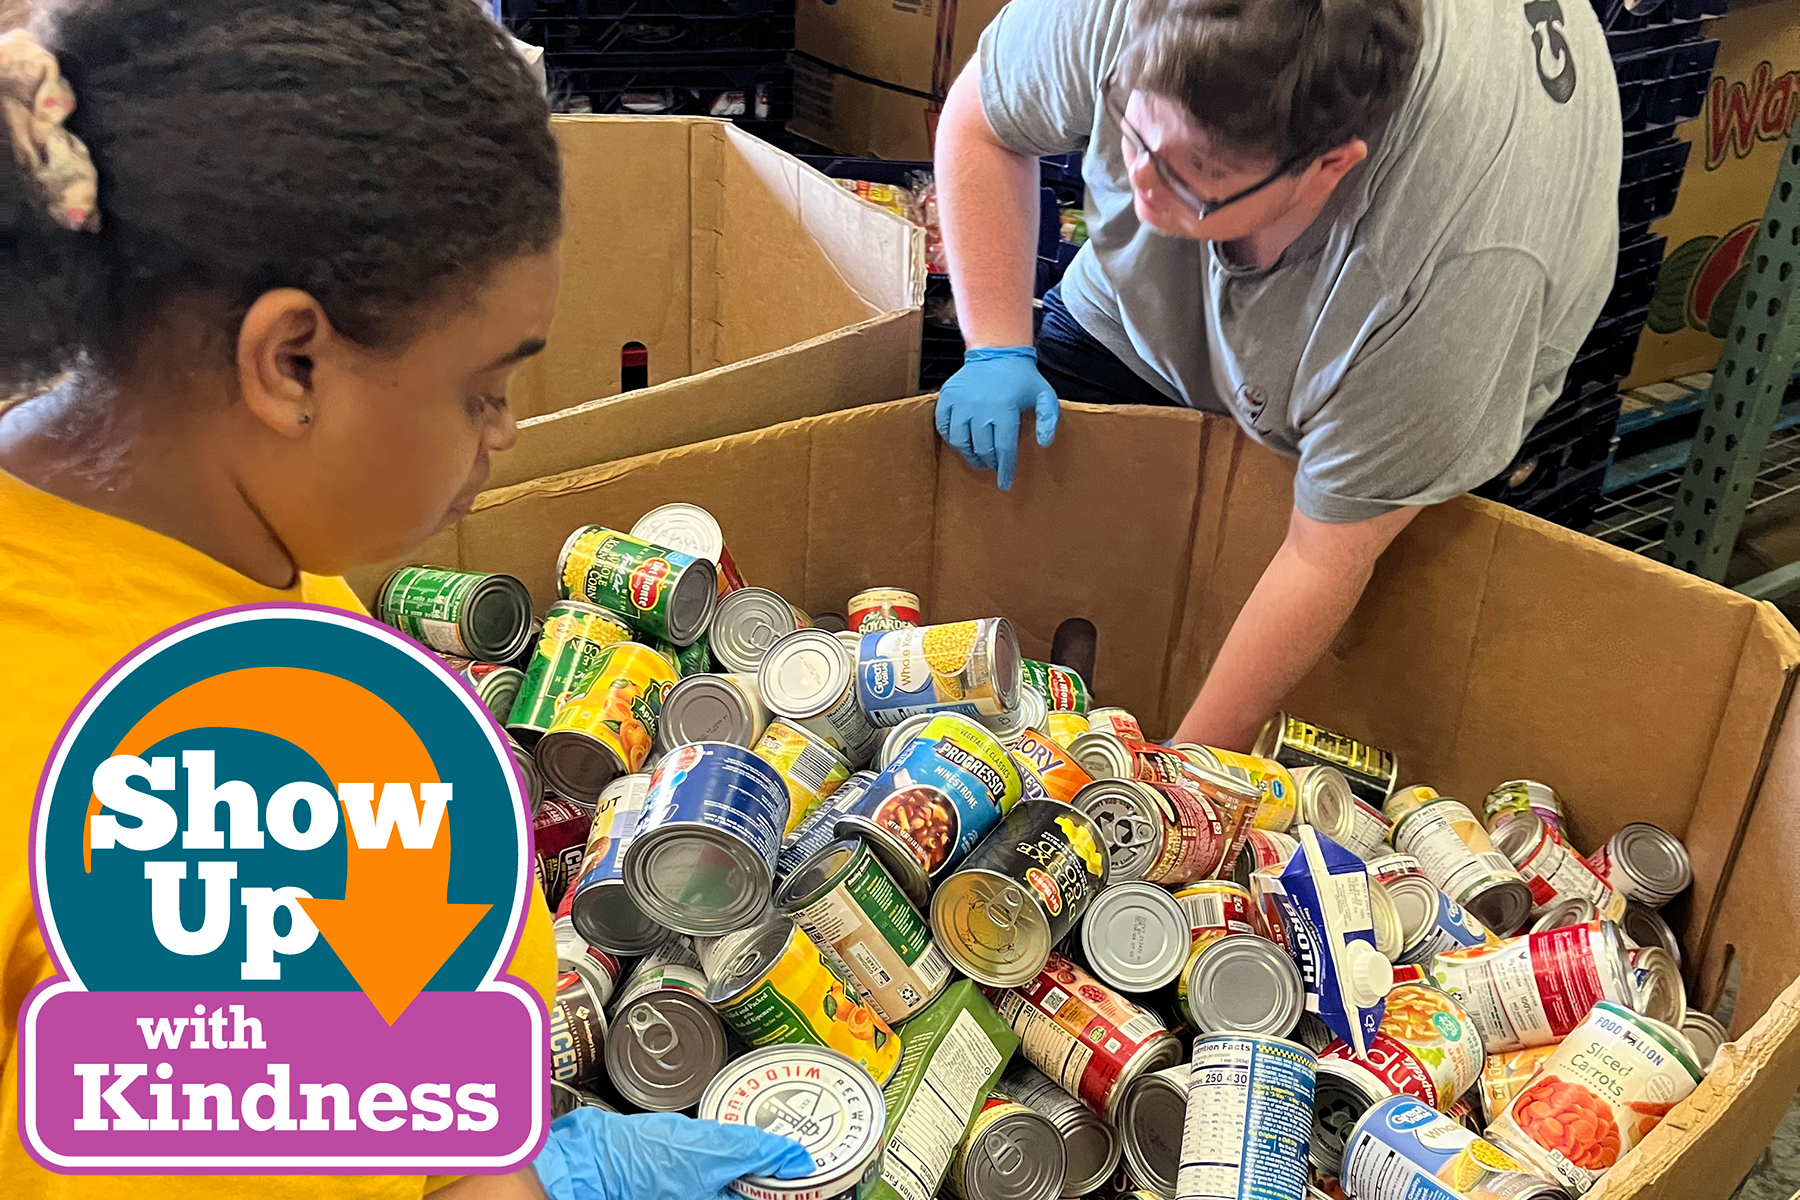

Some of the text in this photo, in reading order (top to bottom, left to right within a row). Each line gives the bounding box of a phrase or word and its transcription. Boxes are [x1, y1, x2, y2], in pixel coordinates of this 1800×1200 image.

[583, 569, 602, 599] CORN
[616, 587, 630, 611] WITH
[638, 561, 665, 607] Del Monte
[874, 658, 885, 694] Great
[881, 660, 889, 690] Value
[902, 653, 911, 686] Whoe
[939, 742, 1003, 796] PROGRESSO
[959, 729, 1010, 779] VEGETABLE CLASSICS
[1014, 733, 1065, 776] LORY
[934, 765, 978, 810] MINESTRONE
[1416, 806, 1436, 818] Facts
[1436, 819, 1447, 828] 20
[1016, 842, 1078, 921] DELUXE
[1038, 839, 1085, 899] GOLD
[1029, 868, 1061, 911] Del Monte
[1282, 902, 1315, 983] BROTH
[738, 1005, 750, 1016] and
[746, 991, 769, 1009] Packed
[749, 1003, 776, 1024] Ripeness
[998, 990, 1015, 1011] Facts
[1022, 1004, 1034, 1017] 30
[1519, 995, 1532, 1014] 100%
[551, 1005, 577, 1080] DICED
[562, 1001, 577, 1034] NATURALLY
[574, 1036, 582, 1057] STEAM
[1594, 1016, 1665, 1067] FOOD LION
[1222, 1043, 1250, 1052] Facts
[1586, 1042, 1634, 1077] Sliced
[1205, 1073, 1223, 1083] 250
[1227, 1074, 1247, 1084] 430
[1401, 1054, 1434, 1108] ampbell's
[1570, 1053, 1624, 1097] Carrots
[724, 1066, 821, 1122] WILD CAUG
[838, 1110, 864, 1149] WELL
[1391, 1105, 1426, 1125] Great
[1424, 1123, 1460, 1139] Whol
[816, 1152, 838, 1167] FO
[889, 1139, 903, 1152] 10
[1405, 1175, 1424, 1200] Quality.
